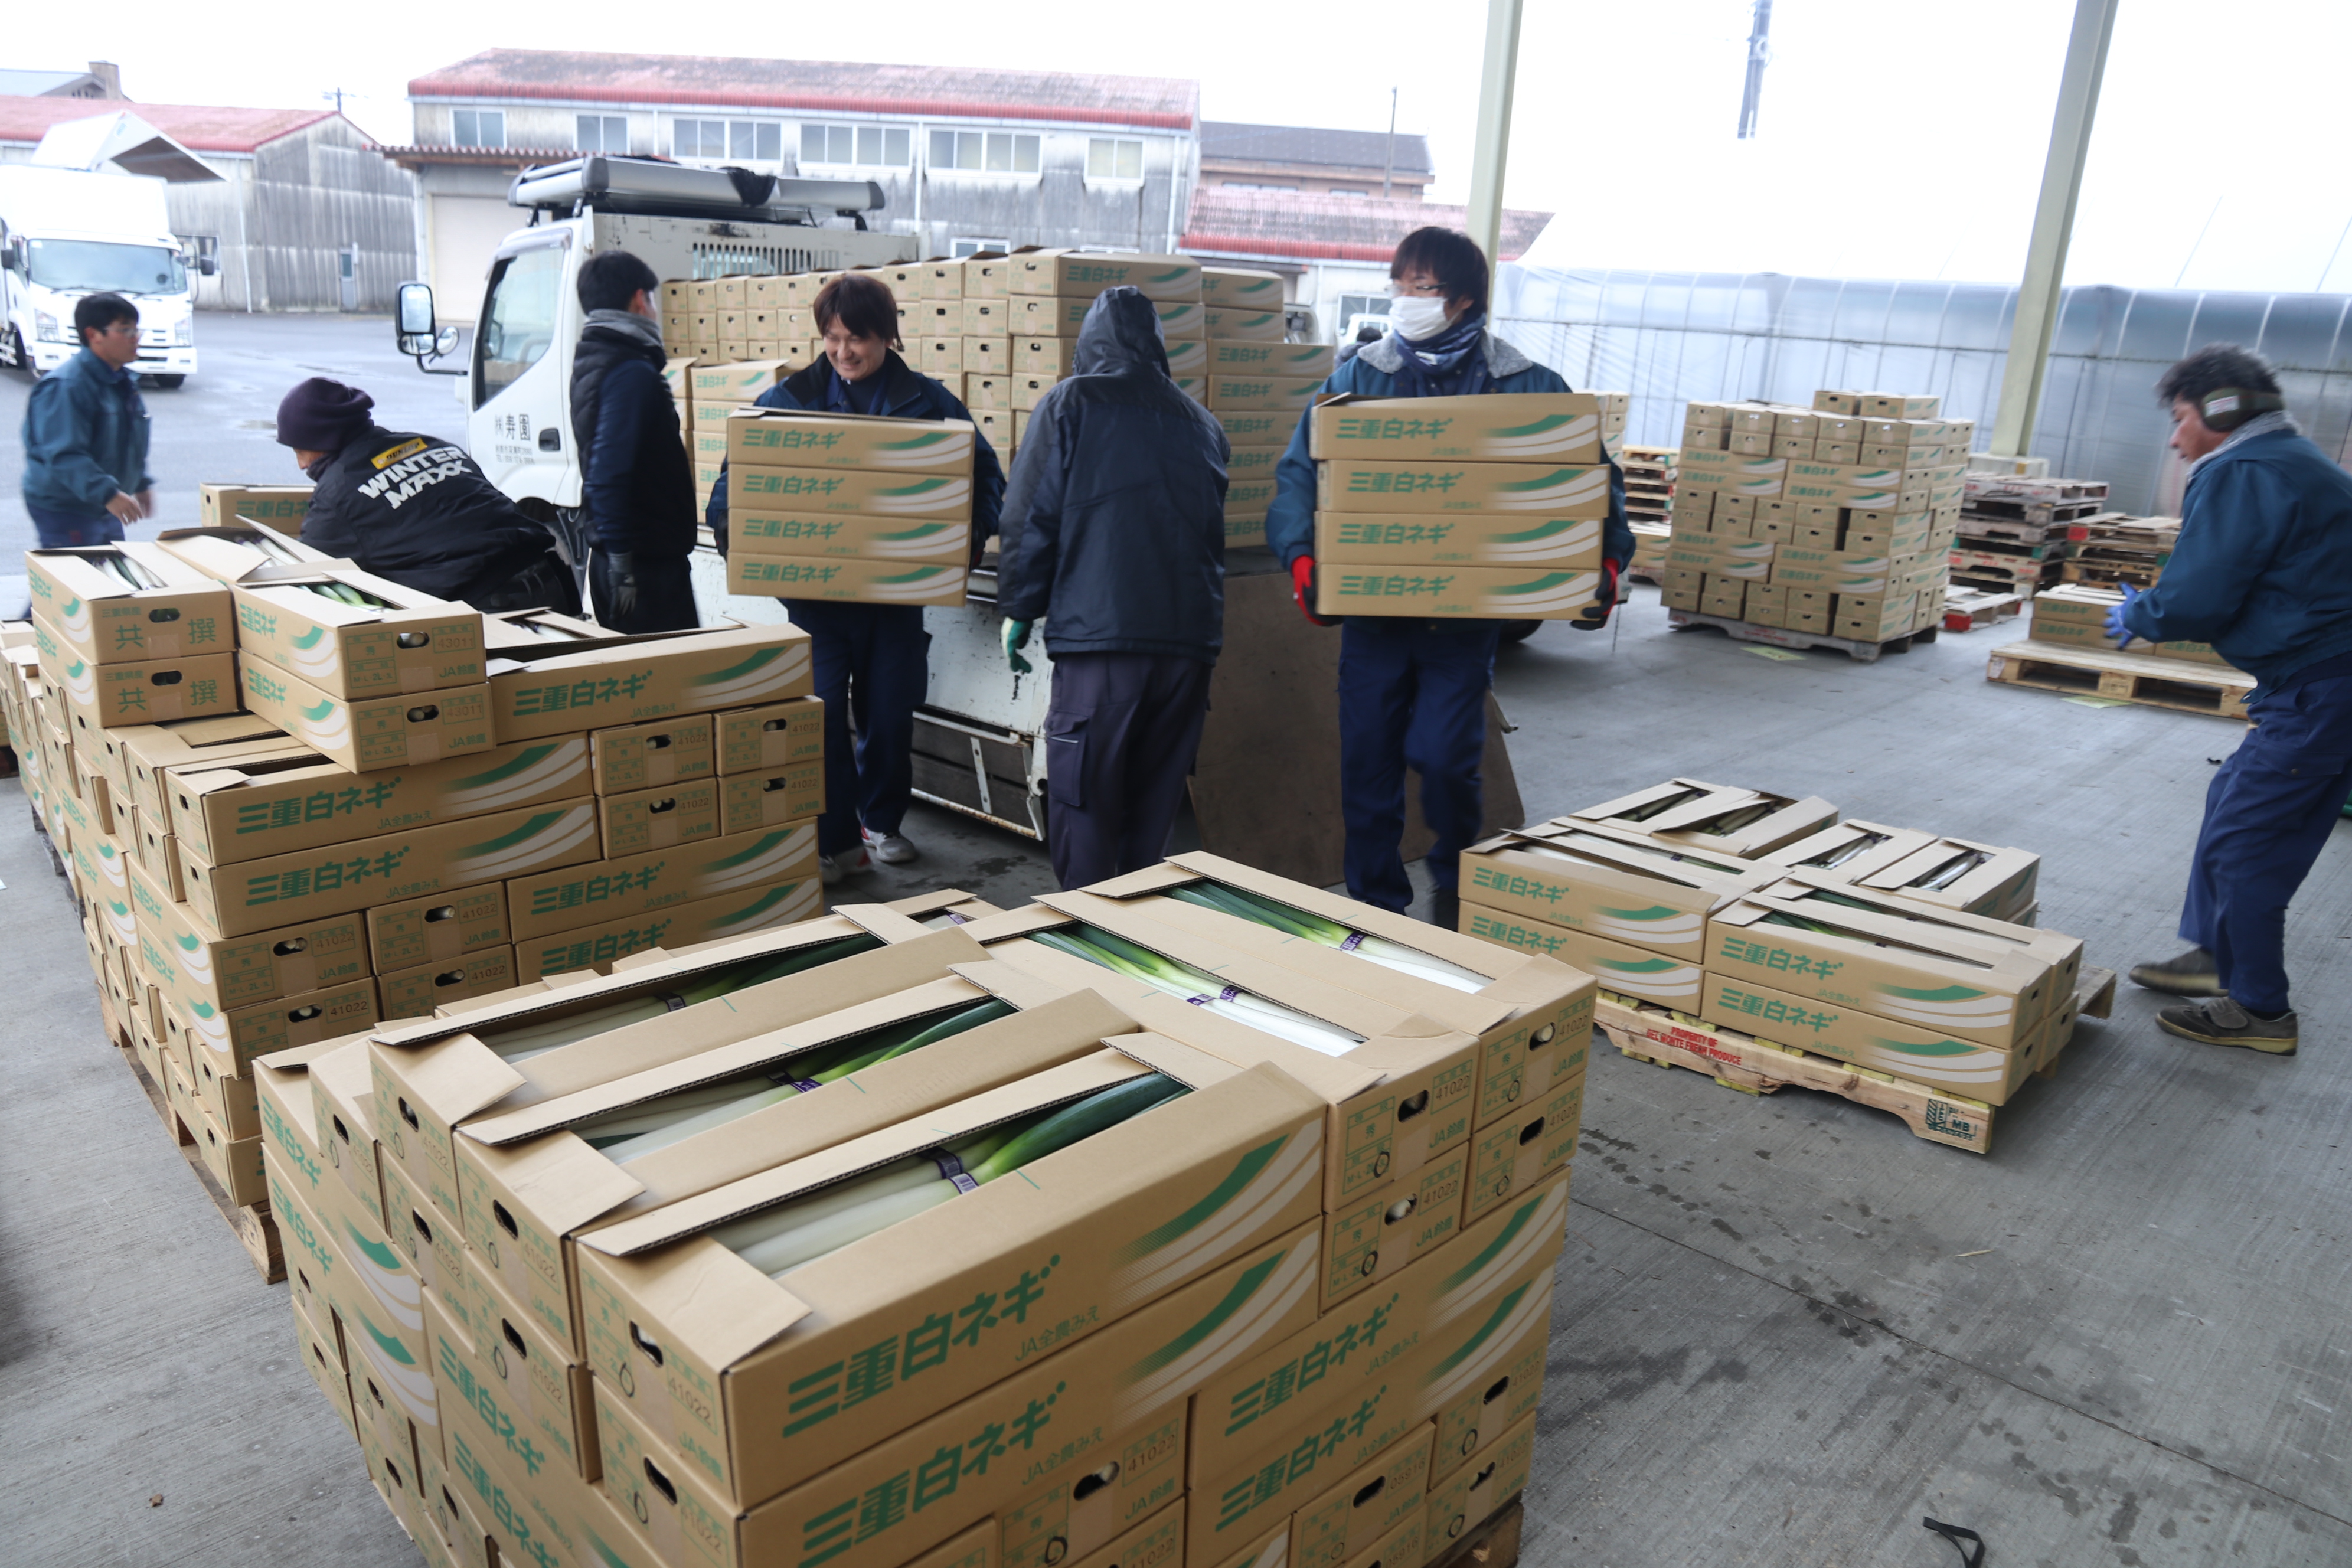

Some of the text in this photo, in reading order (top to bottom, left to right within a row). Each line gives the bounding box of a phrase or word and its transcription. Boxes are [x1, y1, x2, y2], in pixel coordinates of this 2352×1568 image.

[1067, 265, 1129, 283] 三重白ネギ
[742, 428, 845, 449] 三重白ネギ
[1335, 417, 1453, 440] 三重白ネギ
[358, 446, 468, 499] WINTER
[384, 460, 473, 510] MAXX
[743, 475, 844, 495] 三重白ネギ
[1347, 472, 1464, 494] 三重白ネギ
[237, 498, 310, 518] 三重白ネ
[743, 519, 844, 540] 三重白ネギ
[1337, 523, 1454, 545] 三重白ネギ
[741, 563, 842, 583] 三重白ネギ
[1338, 575, 1455, 596] 三重白ネギ
[115, 618, 217, 650] 共 撰
[118, 679, 218, 713] 共 撰
[512, 670, 653, 717] 三重白ネギ
[678, 733, 707, 746] 41022
[792, 721, 820, 734] 41022
[791, 780, 818, 790] 41022
[236, 776, 402, 835] 三重白ネギ
[680, 797, 710, 810] 41022
[377, 810, 433, 830] JA全農みえ
[246, 845, 410, 907] 三重白ネギ
[386, 878, 442, 899] JA全農みえ
[531, 861, 666, 916] 三重白ネギ
[1472, 867, 1570, 904] 三重白ネギ
[463, 904, 497, 919] 41022
[316, 932, 354, 949] 41022
[540, 918, 672, 975] 三重白ネギ
[1470, 916, 1567, 955] 三重白ネギ
[472, 965, 506, 981] 41022
[1720, 936, 1844, 981] 三重白ネギ
[330, 999, 368, 1016] 41022
[1718, 987, 1840, 1033] 三重白ネギ
[1558, 1014, 1588, 1038] 41022
[1435, 1074, 1471, 1102] 41022
[1550, 1102, 1577, 1128] 41022
[262, 1095, 322, 1190] 三重白ネギ
[1423, 1179, 1458, 1205] 41022
[272, 1177, 332, 1276] 三重白ネギ
[782, 1254, 1060, 1439] 三重白ネギ
[1014, 1305, 1100, 1362] JA全農みえ
[1224, 1293, 1400, 1438] 三重白ネギ
[439, 1334, 545, 1478] 三重白ネギ
[668, 1377, 713, 1426] 41022
[1021, 1426, 1105, 1487] JA全農みえ
[1128, 1433, 1176, 1472] 41022
[1215, 1384, 1387, 1533] 三重白ネギ
[797, 1381, 1066, 1568] 三重白ネギ
[1124, 1478, 1175, 1521] JA鈴鹿
